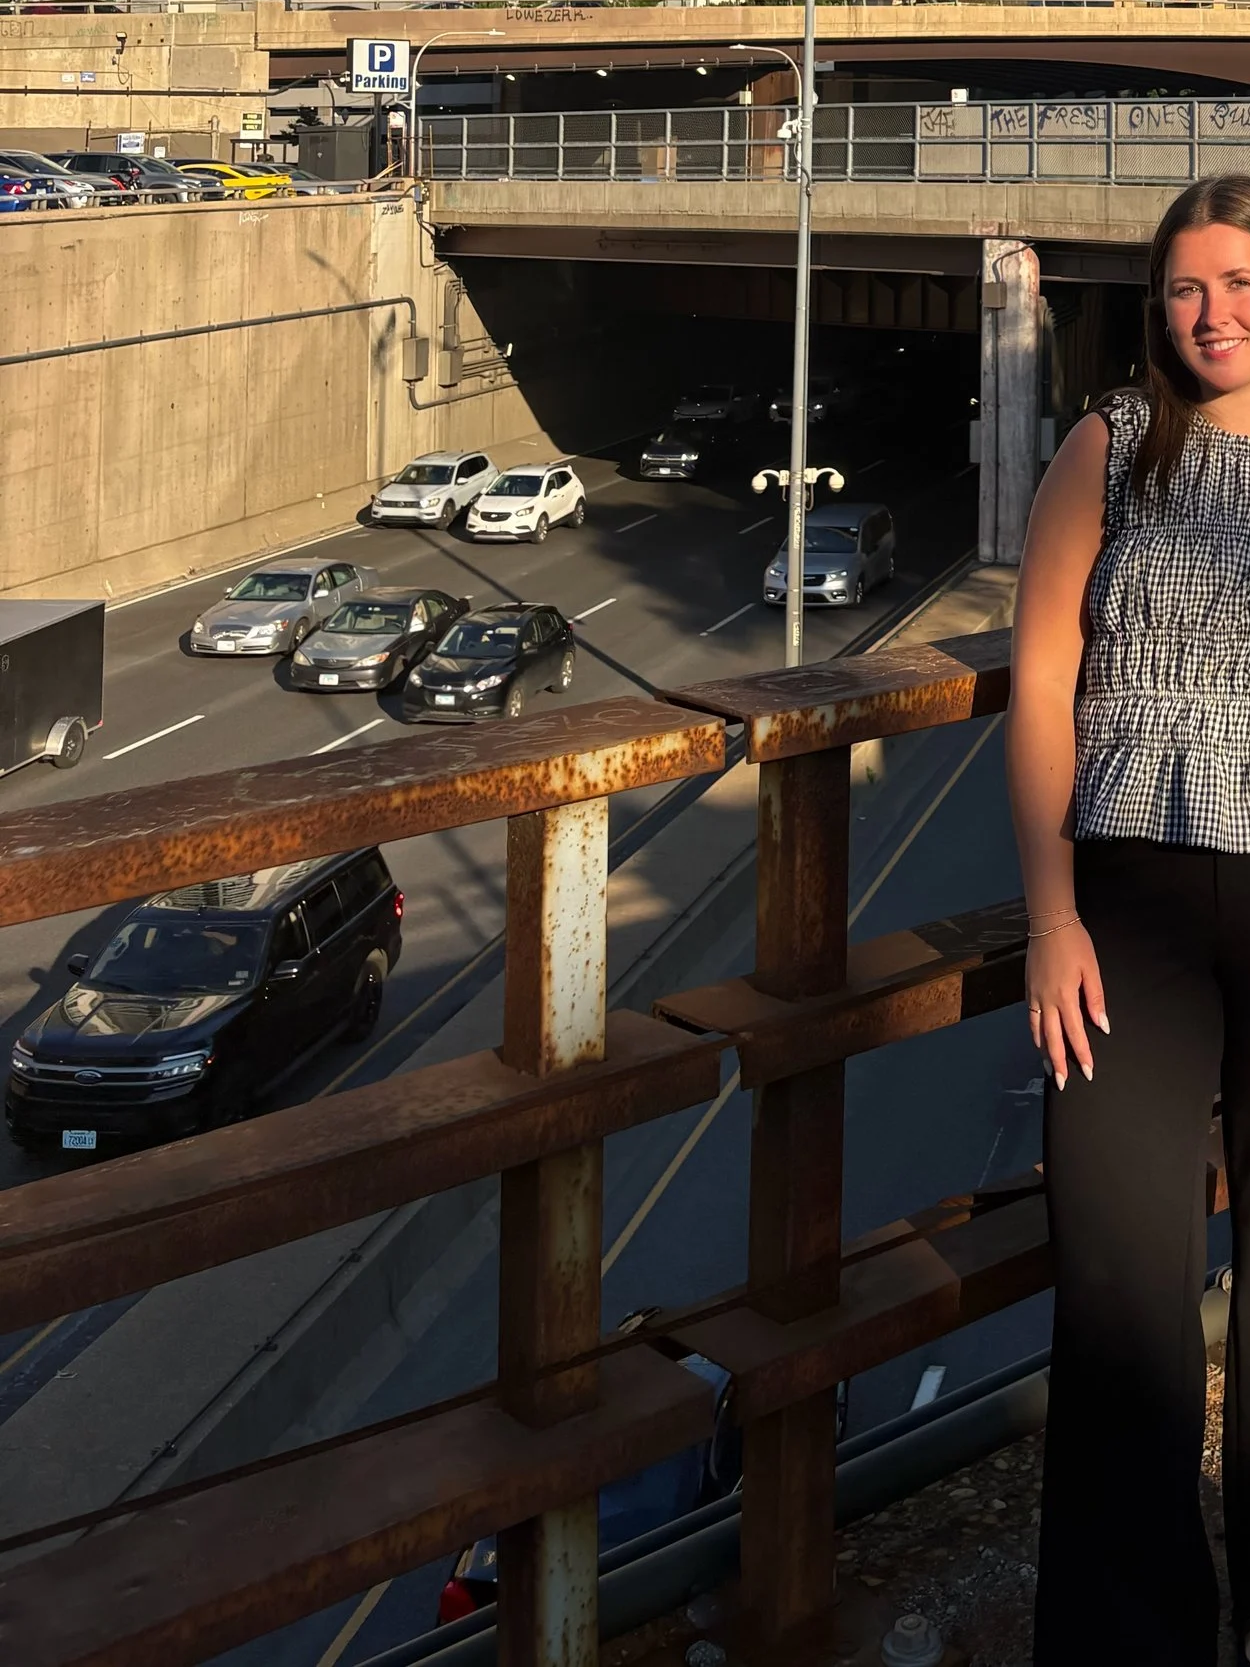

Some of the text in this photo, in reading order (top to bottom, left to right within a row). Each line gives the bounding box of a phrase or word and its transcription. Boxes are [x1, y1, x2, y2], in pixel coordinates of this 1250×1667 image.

[374, 45, 392, 70] P
[355, 74, 407, 91] Parking
[990, 107, 1028, 133] THE
[1037, 105, 1107, 130] FRESH
[1128, 105, 1192, 129] ONES
